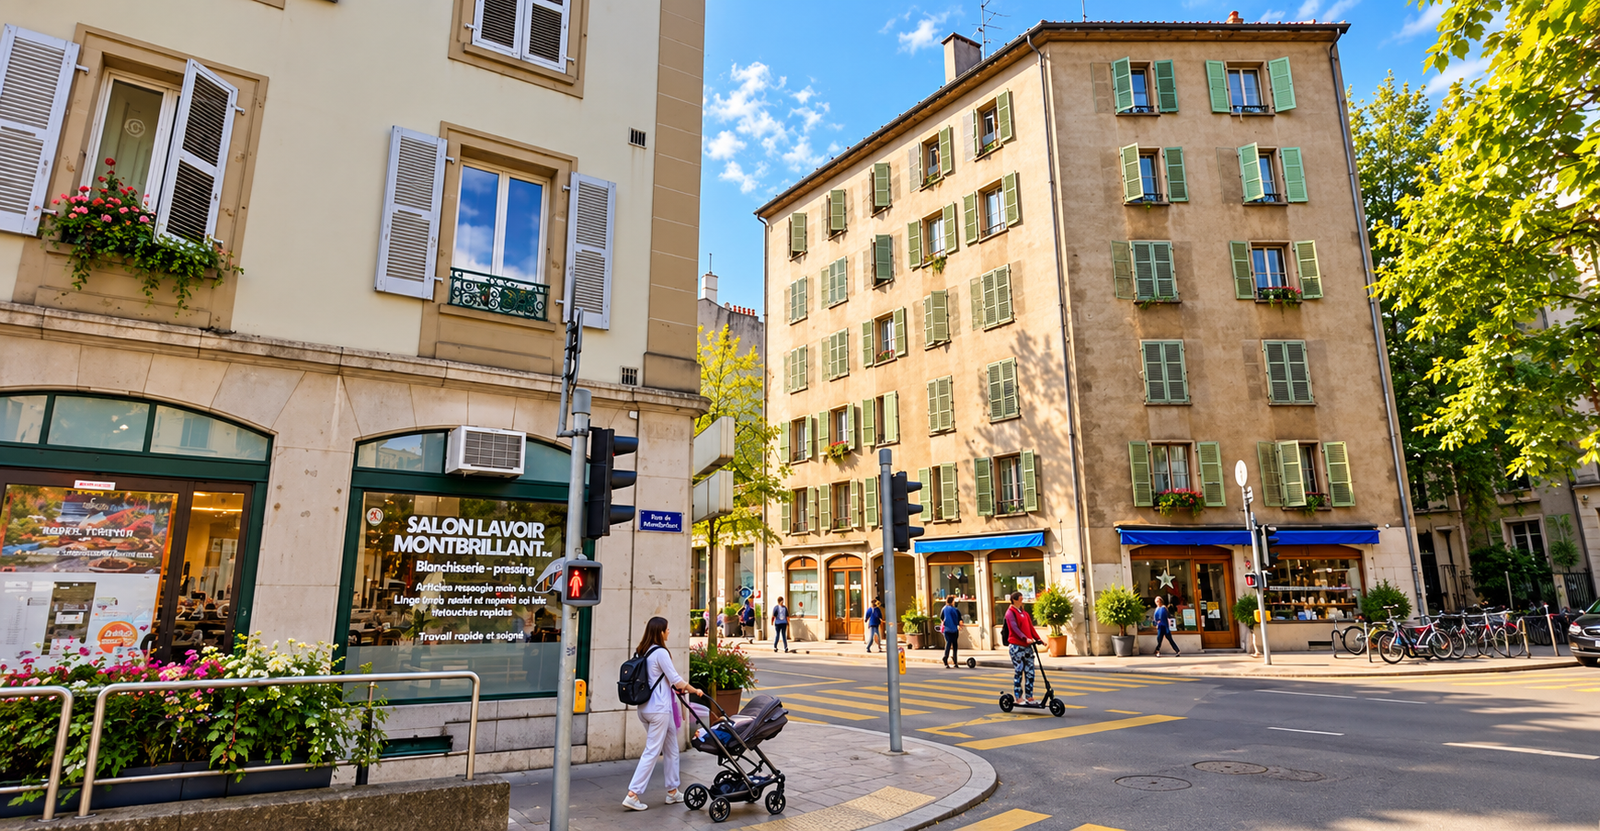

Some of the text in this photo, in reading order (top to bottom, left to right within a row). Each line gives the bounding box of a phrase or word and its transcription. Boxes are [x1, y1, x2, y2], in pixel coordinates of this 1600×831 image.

[407, 516, 545, 539] SALON LAVOIR
[393, 535, 545, 557] MONTBRILLANT
[416, 560, 485, 574] Blanchisserie
[493, 565, 535, 577] pressing
[495, 584, 517, 593] main
[394, 595, 420, 607] Linge
[479, 608, 513, 619] rapides
[454, 631, 484, 643] rapide
[485, 631, 495, 641] et
[496, 630, 524, 642] soigné
